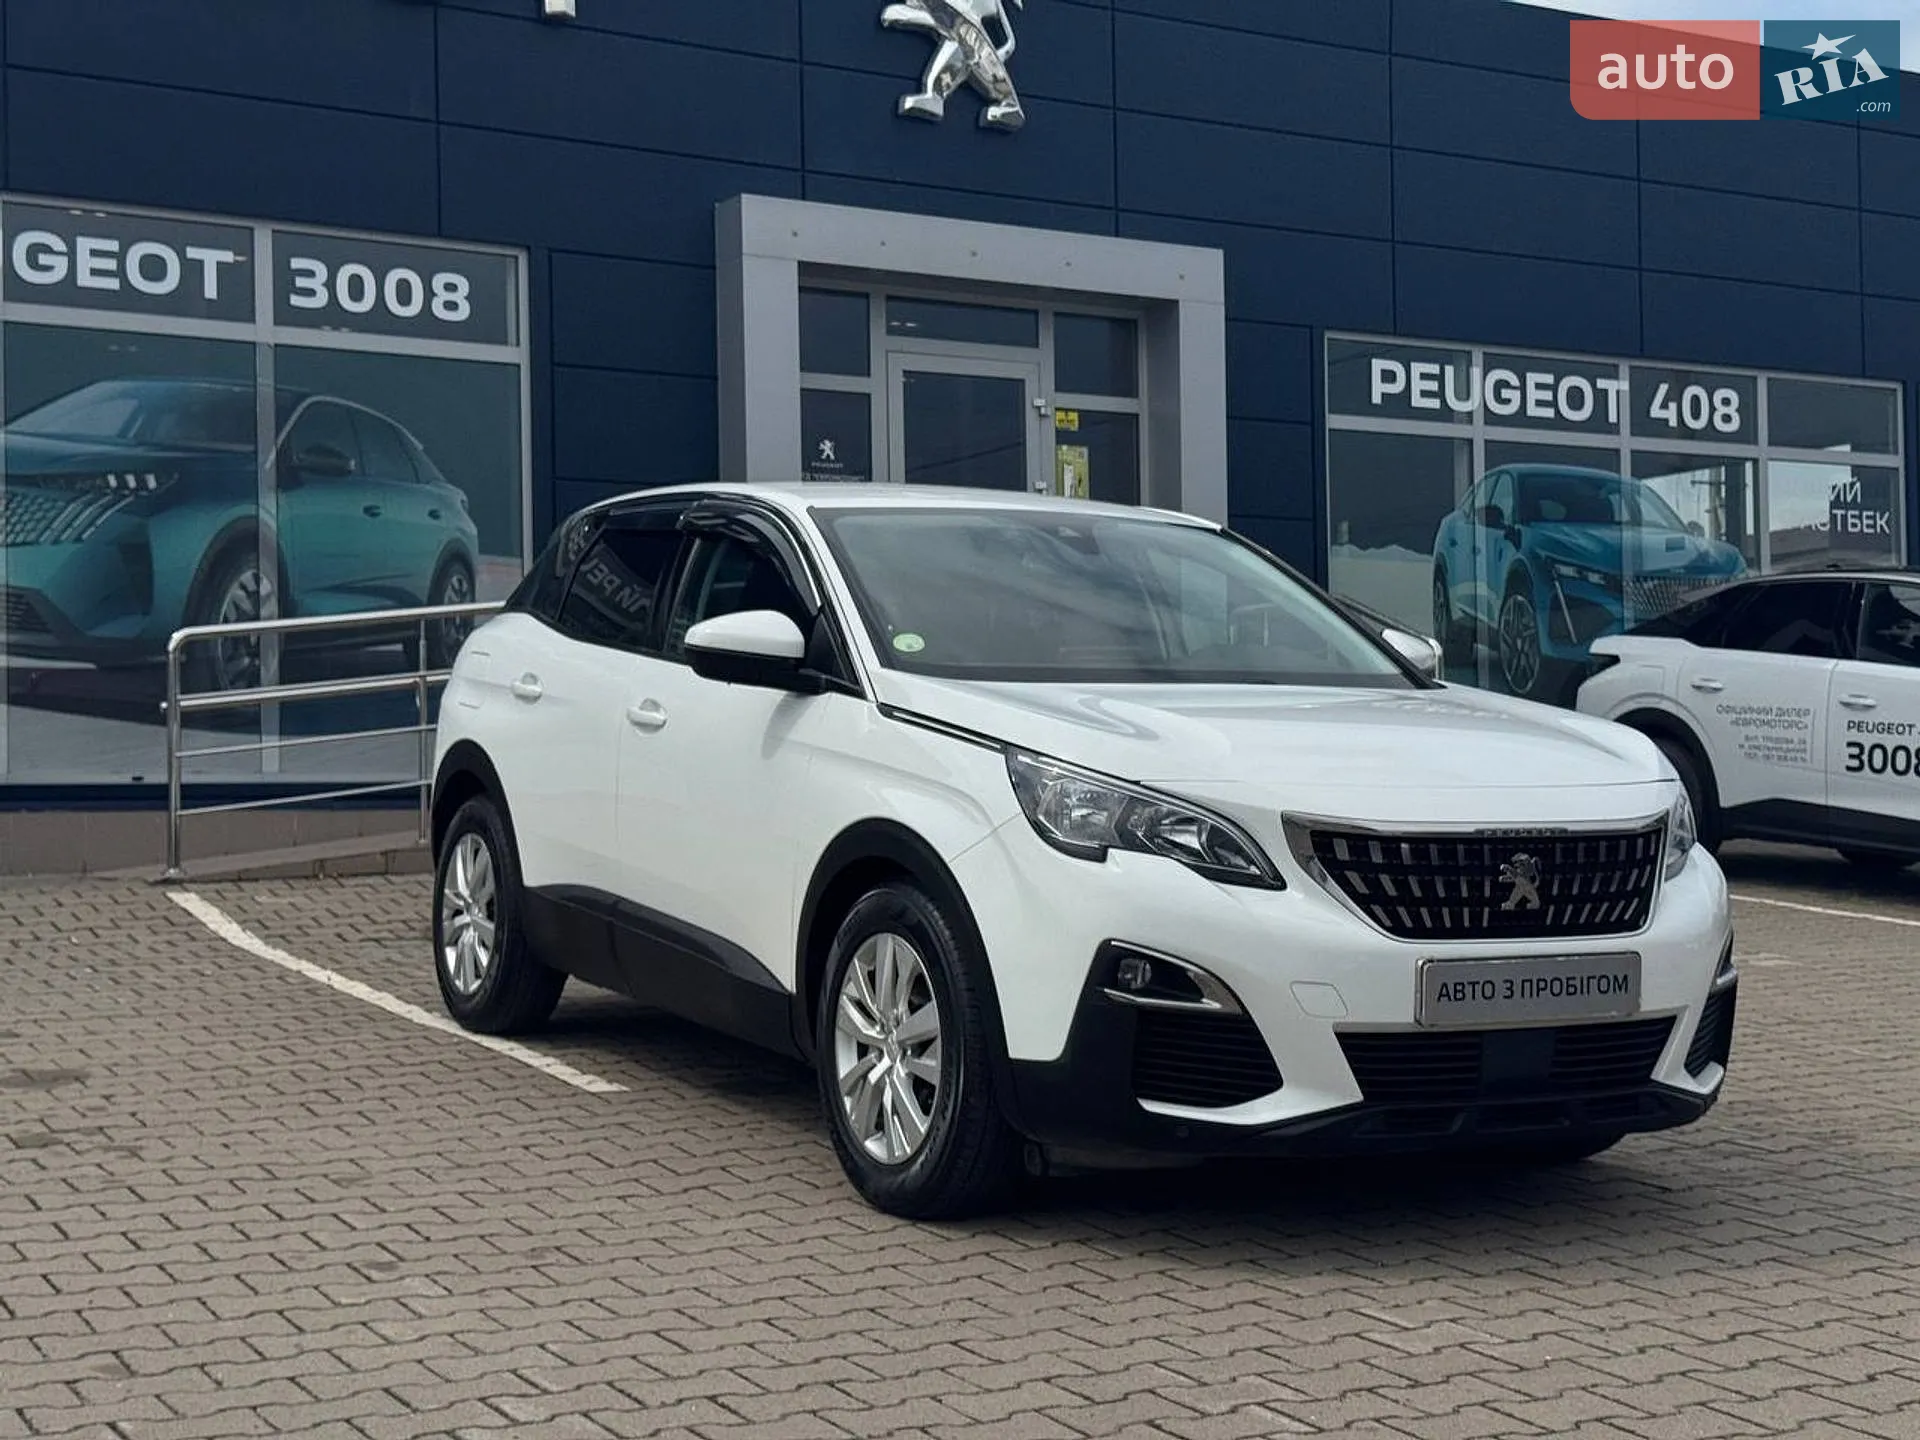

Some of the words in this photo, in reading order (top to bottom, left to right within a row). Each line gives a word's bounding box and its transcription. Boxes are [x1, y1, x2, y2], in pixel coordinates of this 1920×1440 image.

[12, 230, 234, 300] GEOT
[289, 257, 471, 322] 3008
[1371, 358, 1629, 424] PEUGEOT
[1650, 382, 1741, 433] 408
[1847, 720, 1916, 736] PEUGEOT
[1437, 979, 1496, 1002] АВТО
[1520, 973, 1630, 998] ПРОБІГОМ
